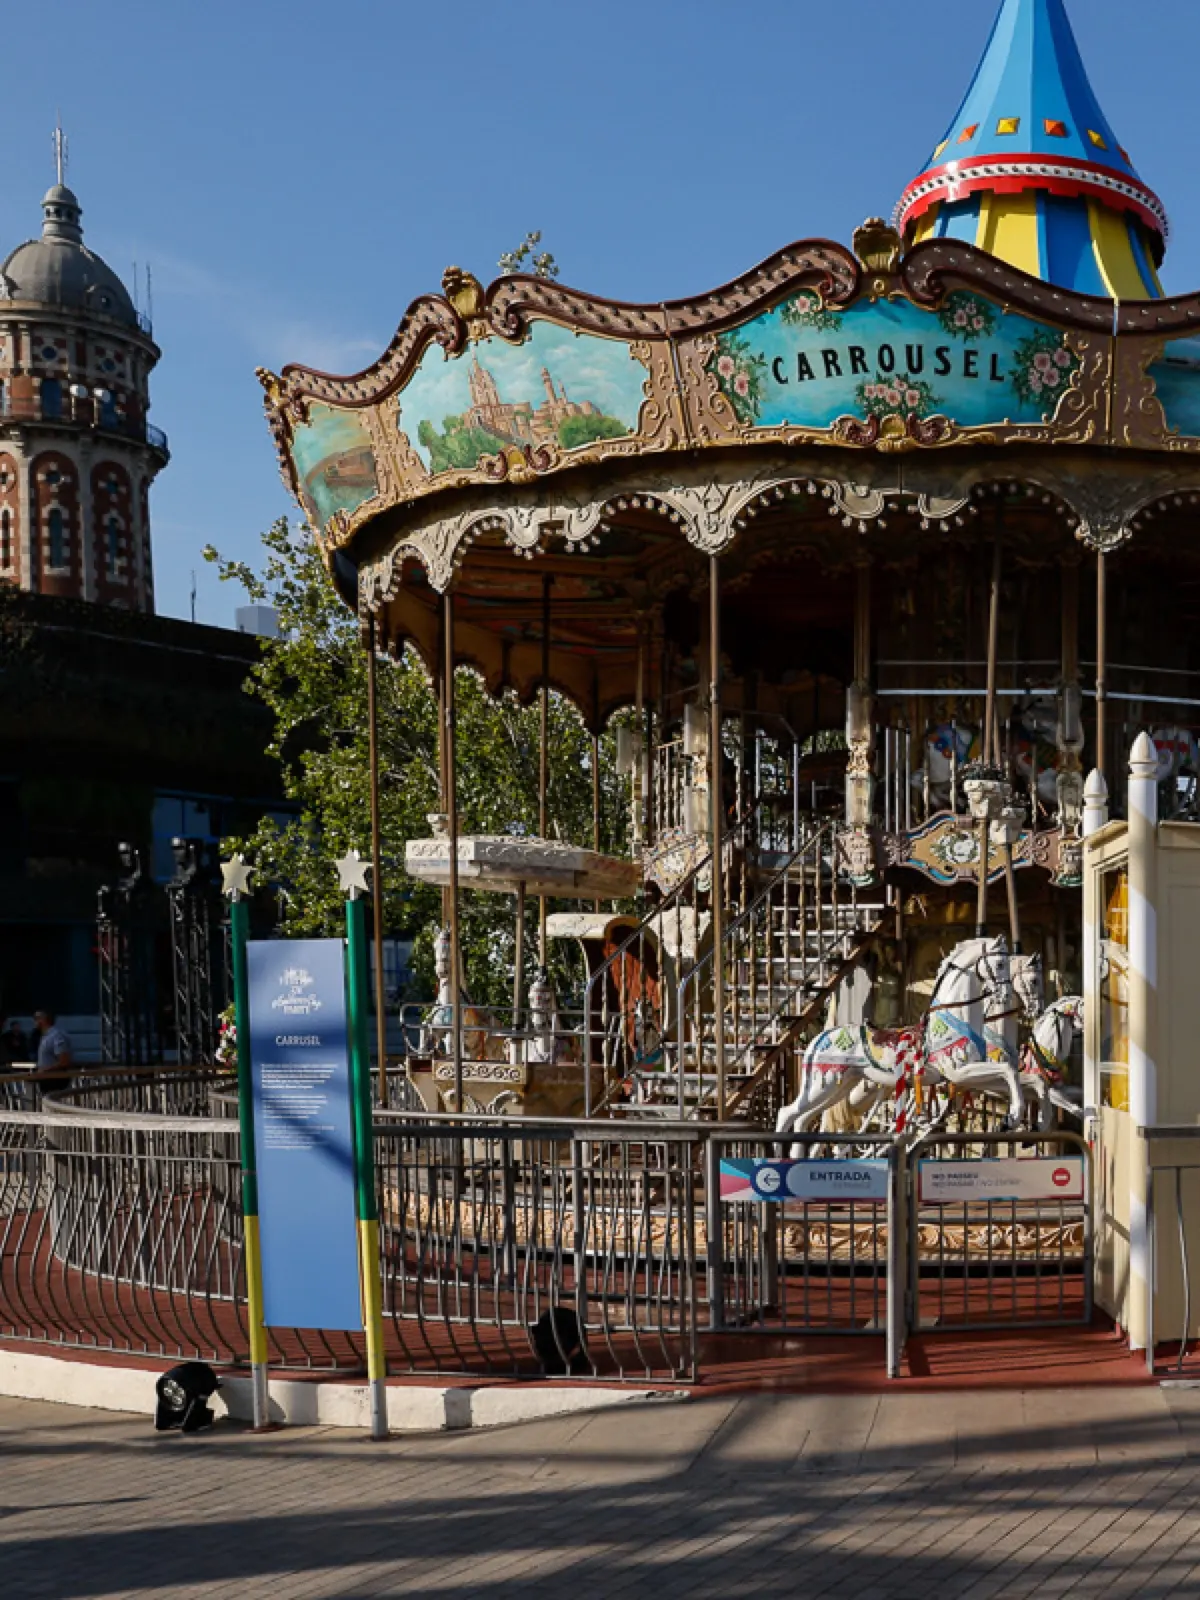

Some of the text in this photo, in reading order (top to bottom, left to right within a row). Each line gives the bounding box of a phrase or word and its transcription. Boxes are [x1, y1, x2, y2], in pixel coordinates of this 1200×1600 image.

[771, 343, 1004, 384] CARROUSEL
[275, 1034, 321, 1047] CARRUSEL
[809, 1171, 872, 1181] ENTRADA
